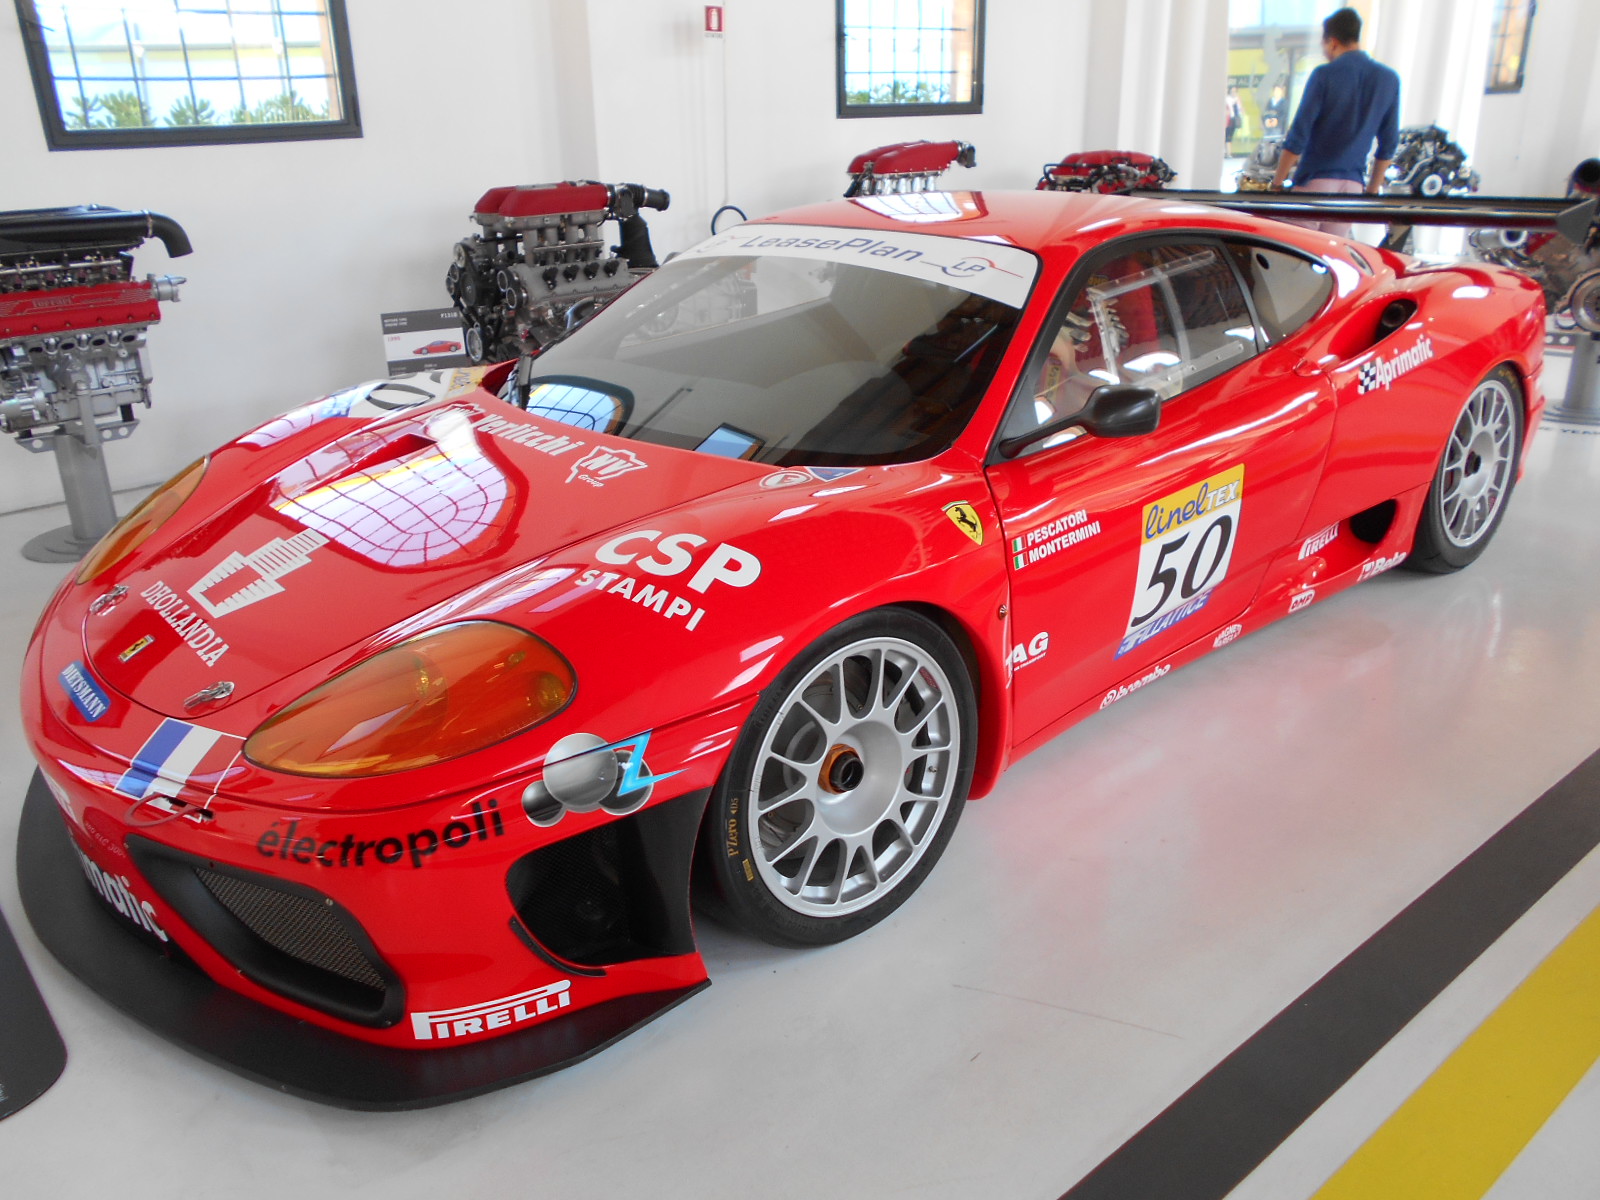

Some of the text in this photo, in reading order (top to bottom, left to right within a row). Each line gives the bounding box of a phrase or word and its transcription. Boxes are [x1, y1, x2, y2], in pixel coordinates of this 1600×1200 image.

[739, 234, 923, 262] LeasePlan
[950, 260, 986, 273] LP
[1375, 333, 1434, 391] Aprimatic
[472, 413, 585, 456] Verlicchi
[578, 474, 605, 488] Group
[580, 453, 634, 474] NV
[1027, 509, 1088, 546] PESCATORI
[1029, 521, 1101, 563] MONTERMINI
[1298, 520, 1340, 560] PIRELLI
[595, 530, 762, 593] CSP
[1131, 514, 1232, 627] 50
[1371, 551, 1407, 577] Beta
[575, 569, 706, 631] STAMPI
[140, 580, 230, 667] DHOLLANDIA
[61, 664, 107, 718] DIETSMANN
[1115, 664, 1171, 702] brembo
[257, 798, 505, 869] électropoli
[410, 979, 572, 1040] PIRELLI
